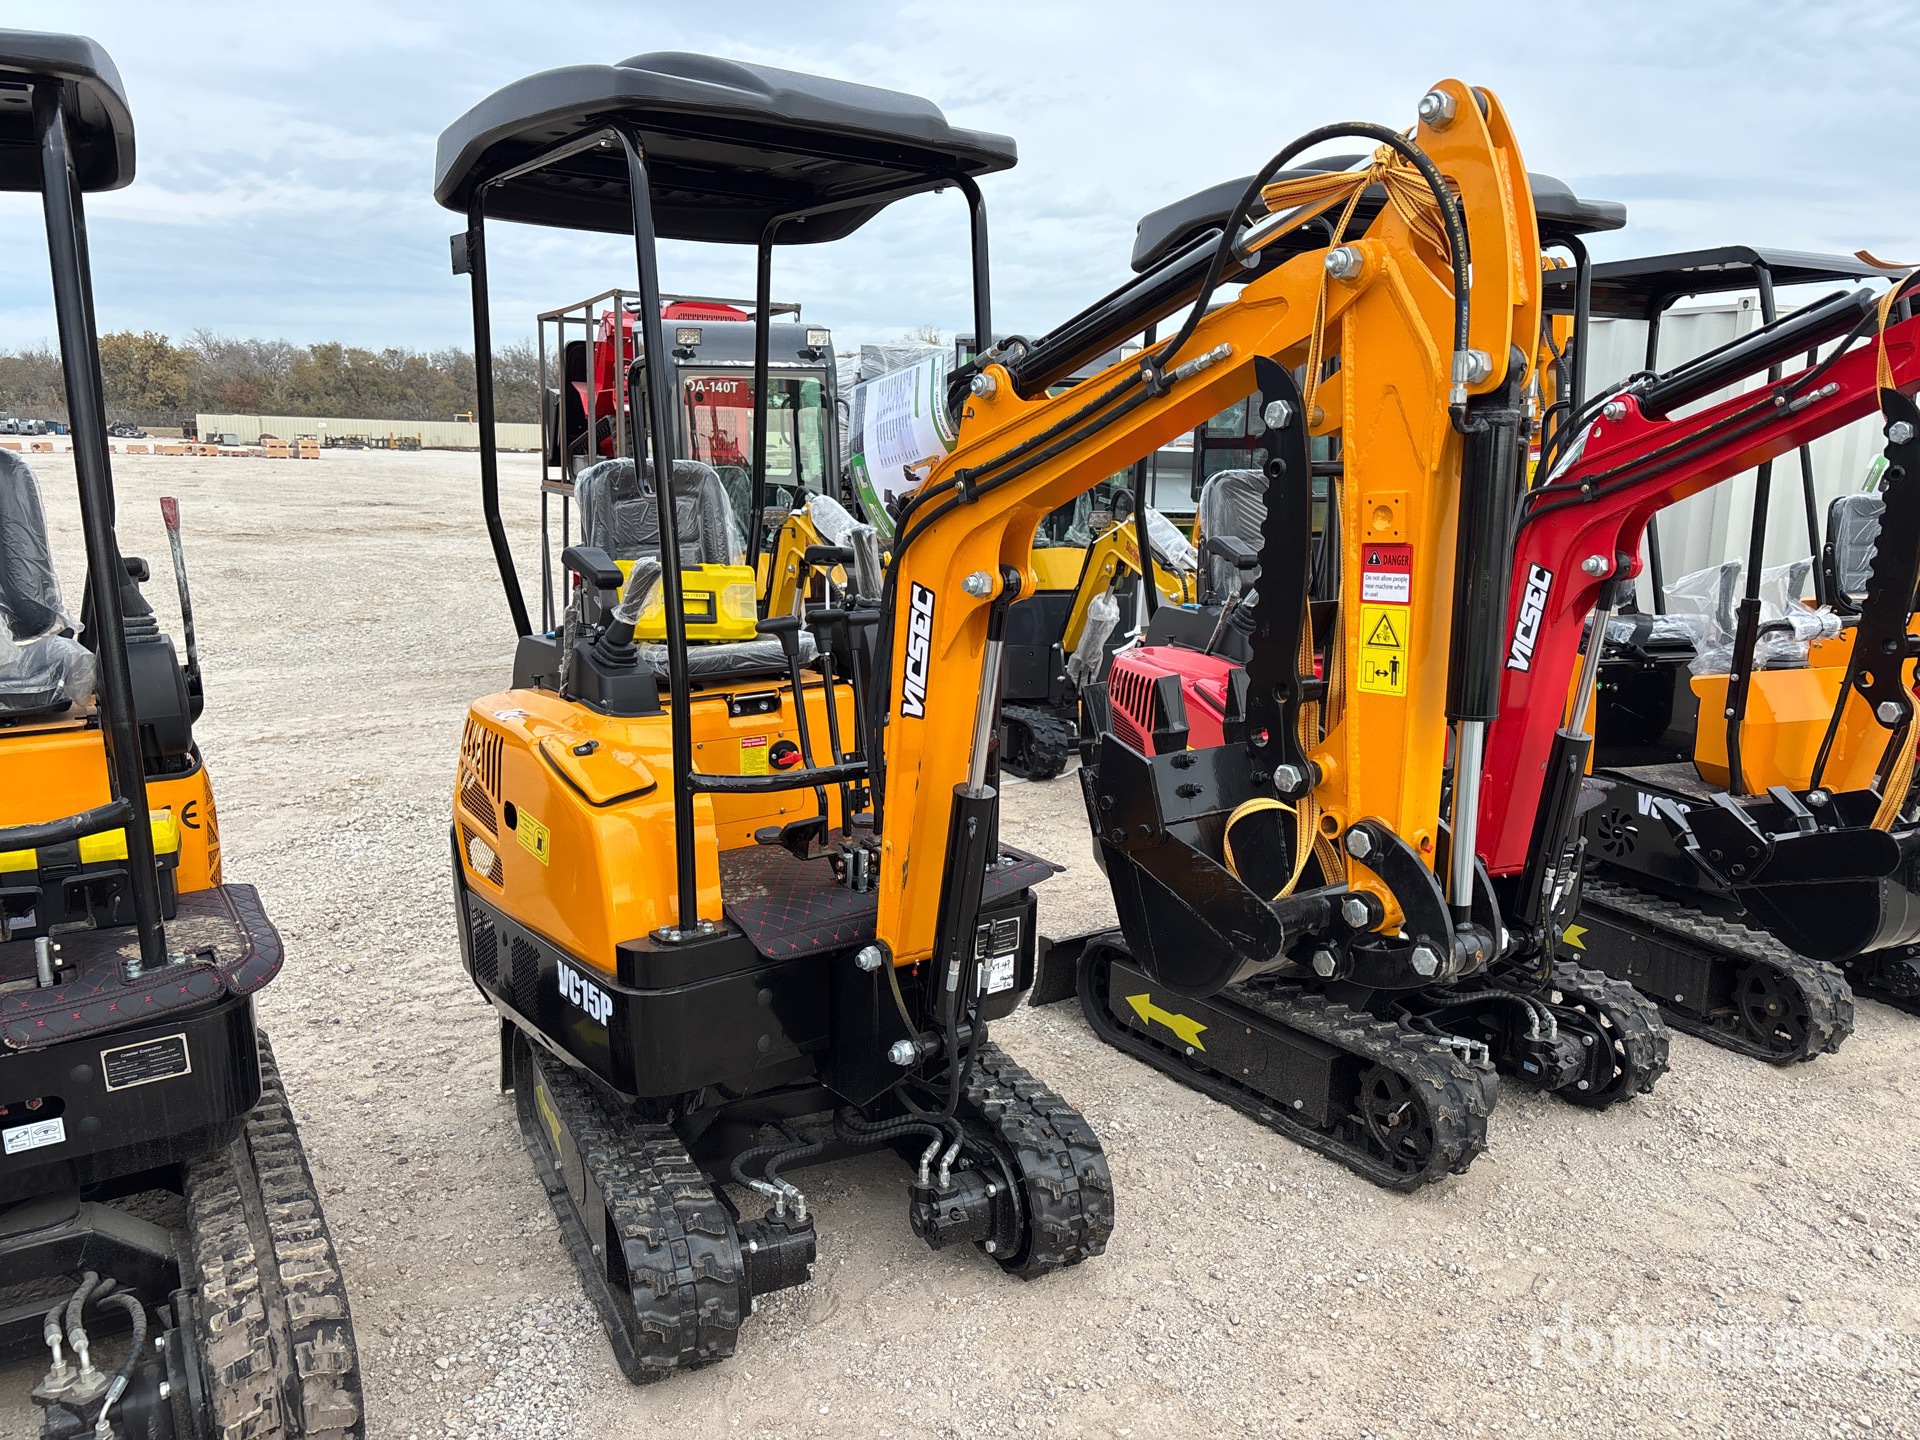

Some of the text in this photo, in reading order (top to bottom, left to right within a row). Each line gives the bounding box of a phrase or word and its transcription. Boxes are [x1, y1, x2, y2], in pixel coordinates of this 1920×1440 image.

[1383, 554, 1409, 566] DANGER
[1392, 576, 1408, 584] people
[1505, 562, 1553, 672] VICSEC
[901, 581, 935, 719] VICSEC
[556, 959, 613, 1027] VC15P
[120, 1045, 163, 1058] Crawler Excavator
